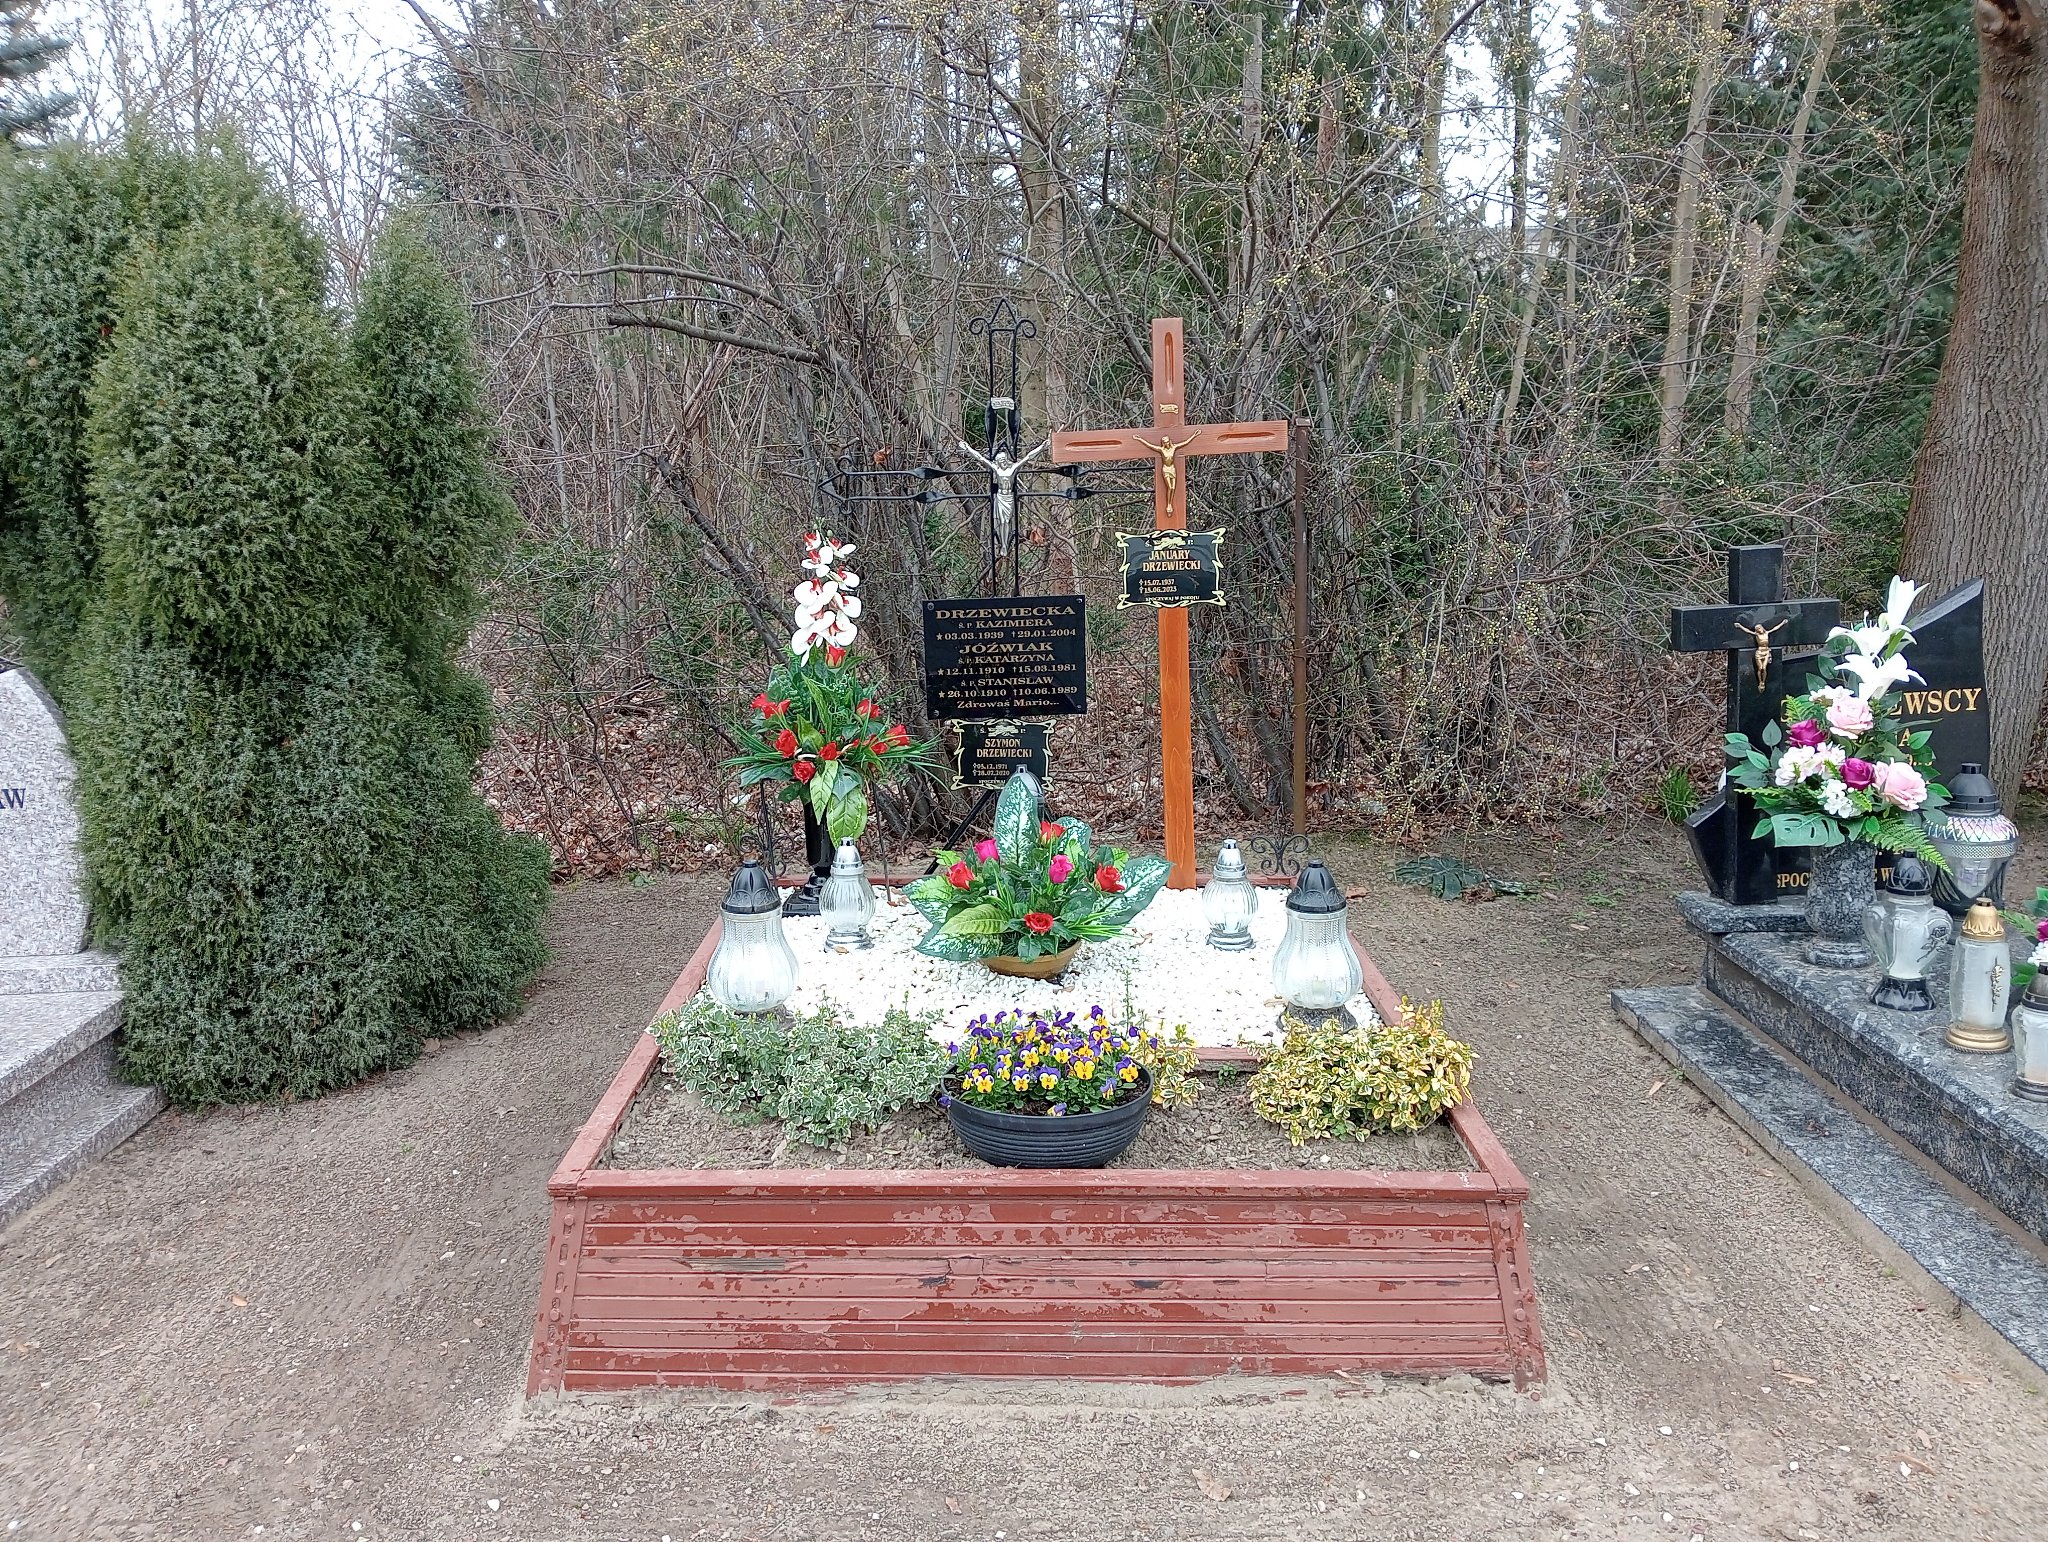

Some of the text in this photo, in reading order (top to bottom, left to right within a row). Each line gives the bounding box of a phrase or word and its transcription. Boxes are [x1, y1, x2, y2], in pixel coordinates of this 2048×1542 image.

[1148, 550, 1190, 560] JANUARY
[1143, 560, 1201, 571] DRZEWIECKI
[935, 606, 1076, 619] DRZEWIECKA
[976, 619, 1053, 629] KAZIMIERA
[944, 629, 1076, 640] 03.03.1939 29.01.2004
[959, 642, 1054, 654] JÓŹWIAK
[974, 654, 1056, 664] KATARZYNA
[945, 664, 1077, 676] 12.11.1910 15.03.1981
[947, 689, 1007, 698] 26.10.1910
[957, 700, 1010, 709] Zdrowaś
[984, 738, 1021, 748] SZYMON
[976, 748, 1032, 758] DRZEWIECKI
